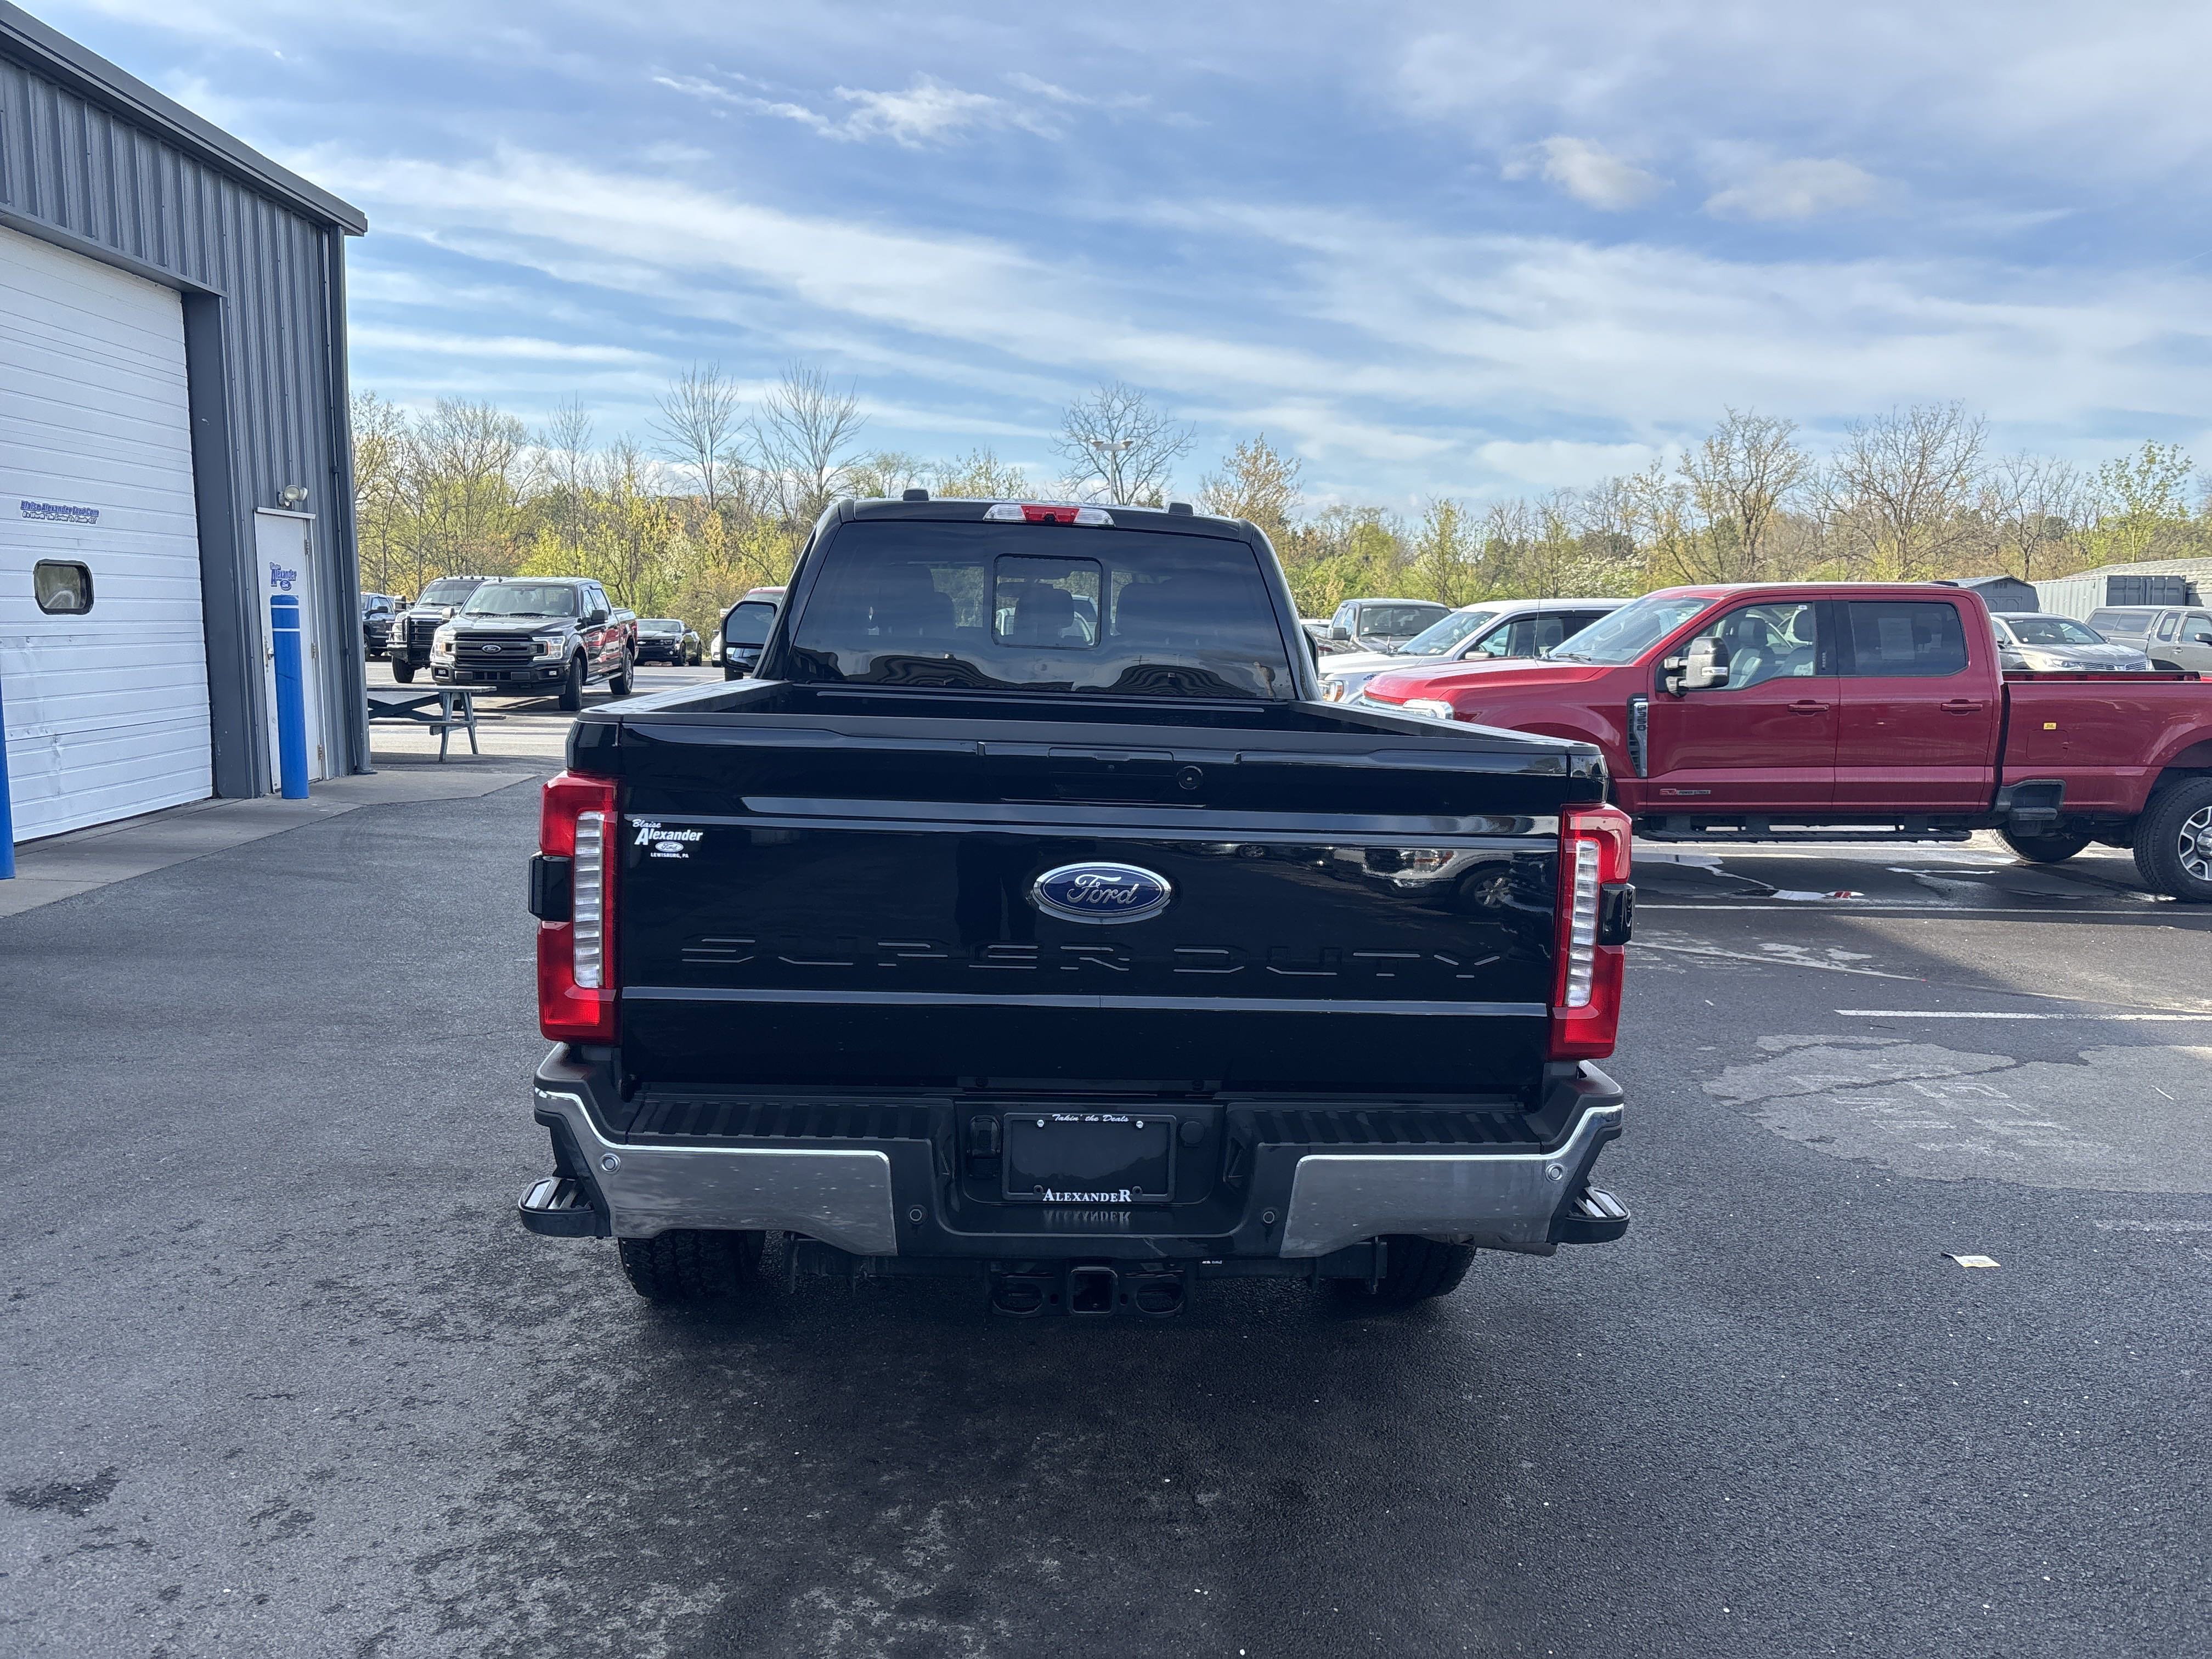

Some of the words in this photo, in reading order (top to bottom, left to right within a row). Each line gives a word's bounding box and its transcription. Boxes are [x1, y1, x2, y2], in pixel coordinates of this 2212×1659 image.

[632, 819, 662, 828] Blaise
[634, 828, 703, 845] Alexander
[1066, 874, 1139, 905] Ford
[681, 933, 1133, 972] SUPER
[1173, 945, 1501, 979] DUTY
[1052, 1114, 1083, 1122] Takin'
[1102, 1114, 1129, 1122] Deals
[1042, 1188, 1132, 1203] ALEXANDER
